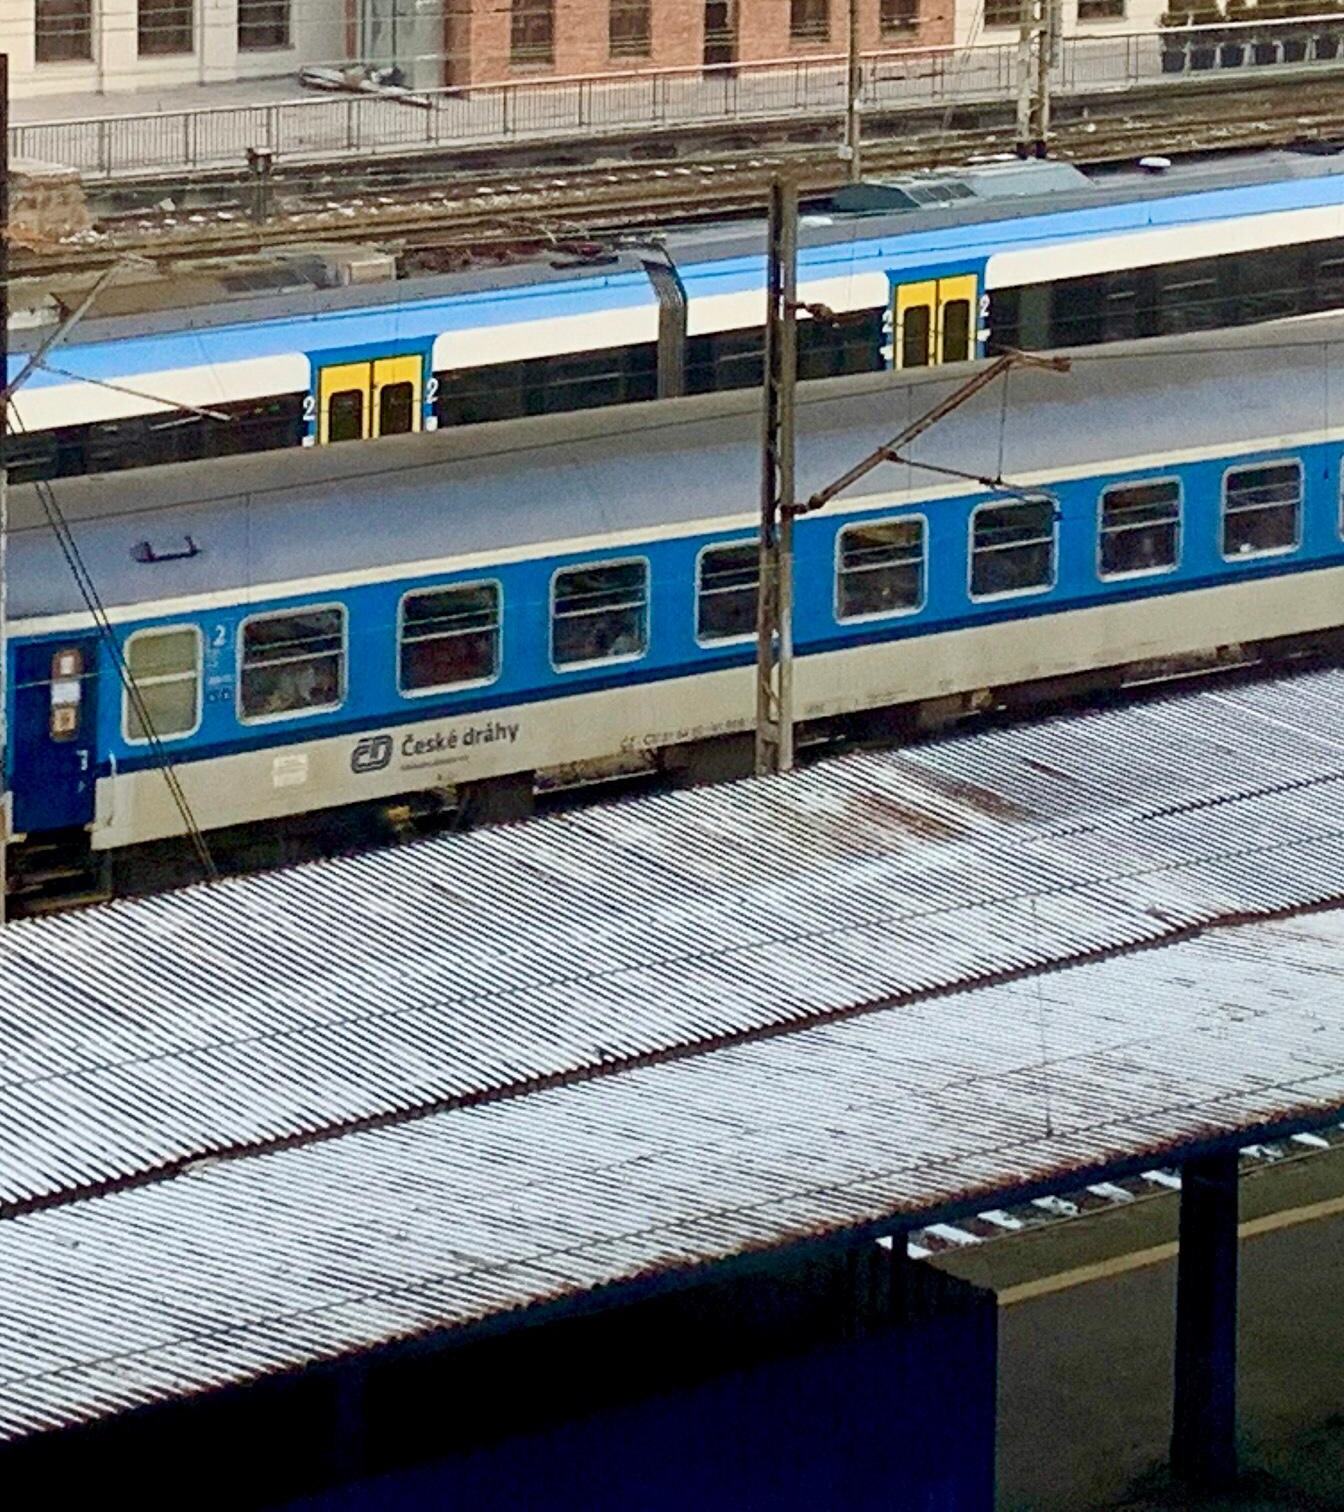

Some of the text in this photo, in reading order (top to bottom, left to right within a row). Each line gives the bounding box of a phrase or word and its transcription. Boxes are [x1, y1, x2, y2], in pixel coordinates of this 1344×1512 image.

[979, 293, 991, 318] 2
[881, 310, 893, 333] 2
[426, 377, 439, 403] 2
[302, 395, 316, 421] 2
[212, 623, 226, 647] 2
[400, 729, 458, 757] České
[462, 720, 520, 747] dráhy
